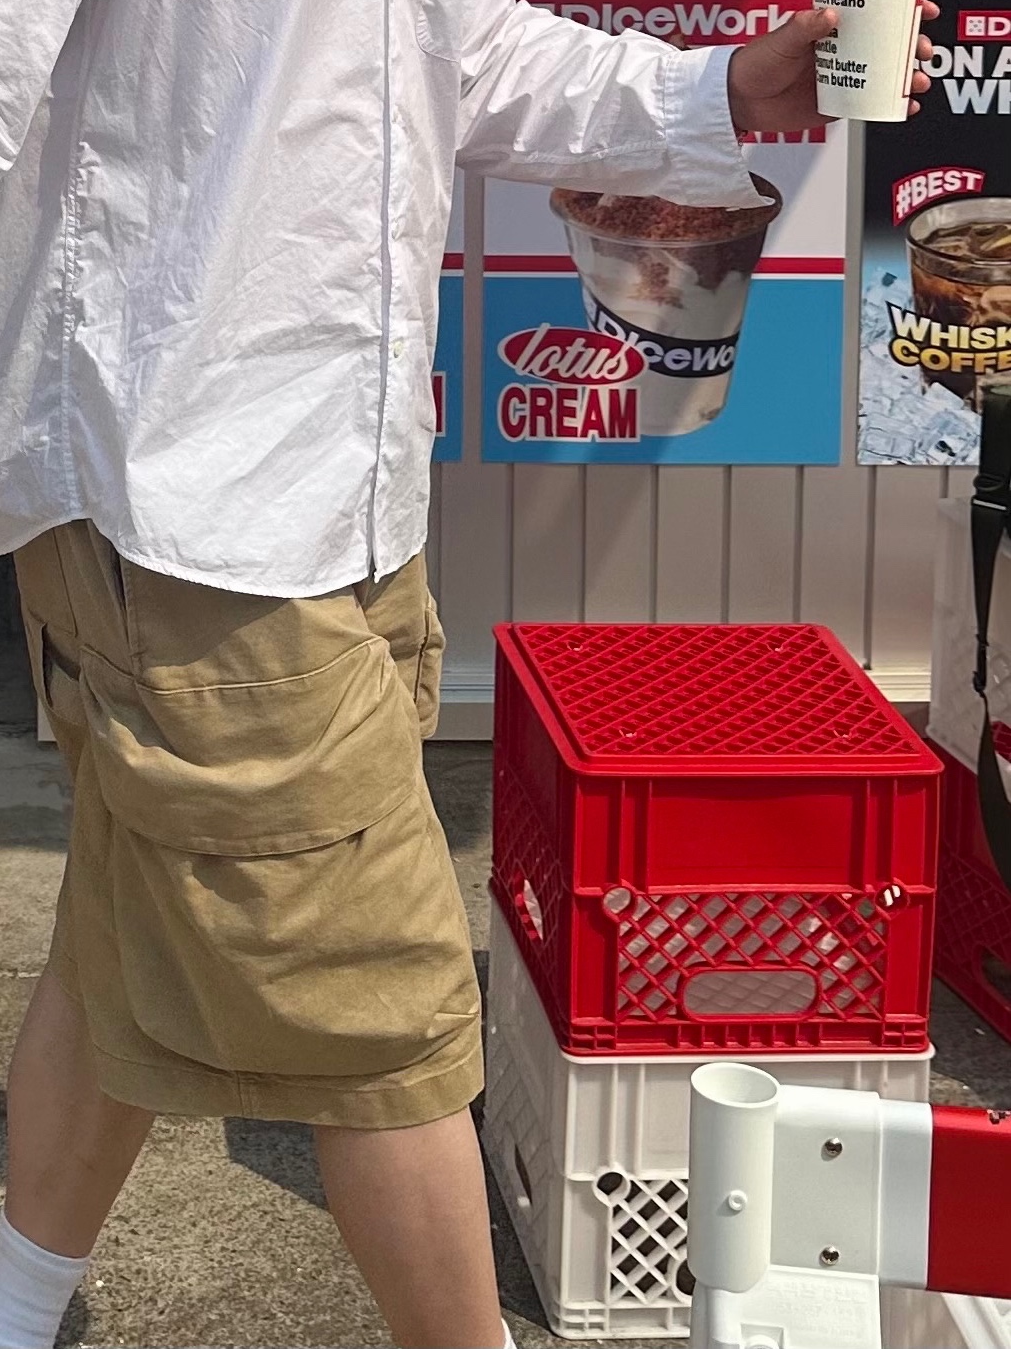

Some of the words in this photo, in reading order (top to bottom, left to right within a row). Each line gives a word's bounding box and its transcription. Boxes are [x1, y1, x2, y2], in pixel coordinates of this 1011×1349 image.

[831, 72, 866, 89] butter
[835, 58, 867, 73] butter
[896, 169, 982, 219] #BEST
[500, 386, 639, 440] CREAM
